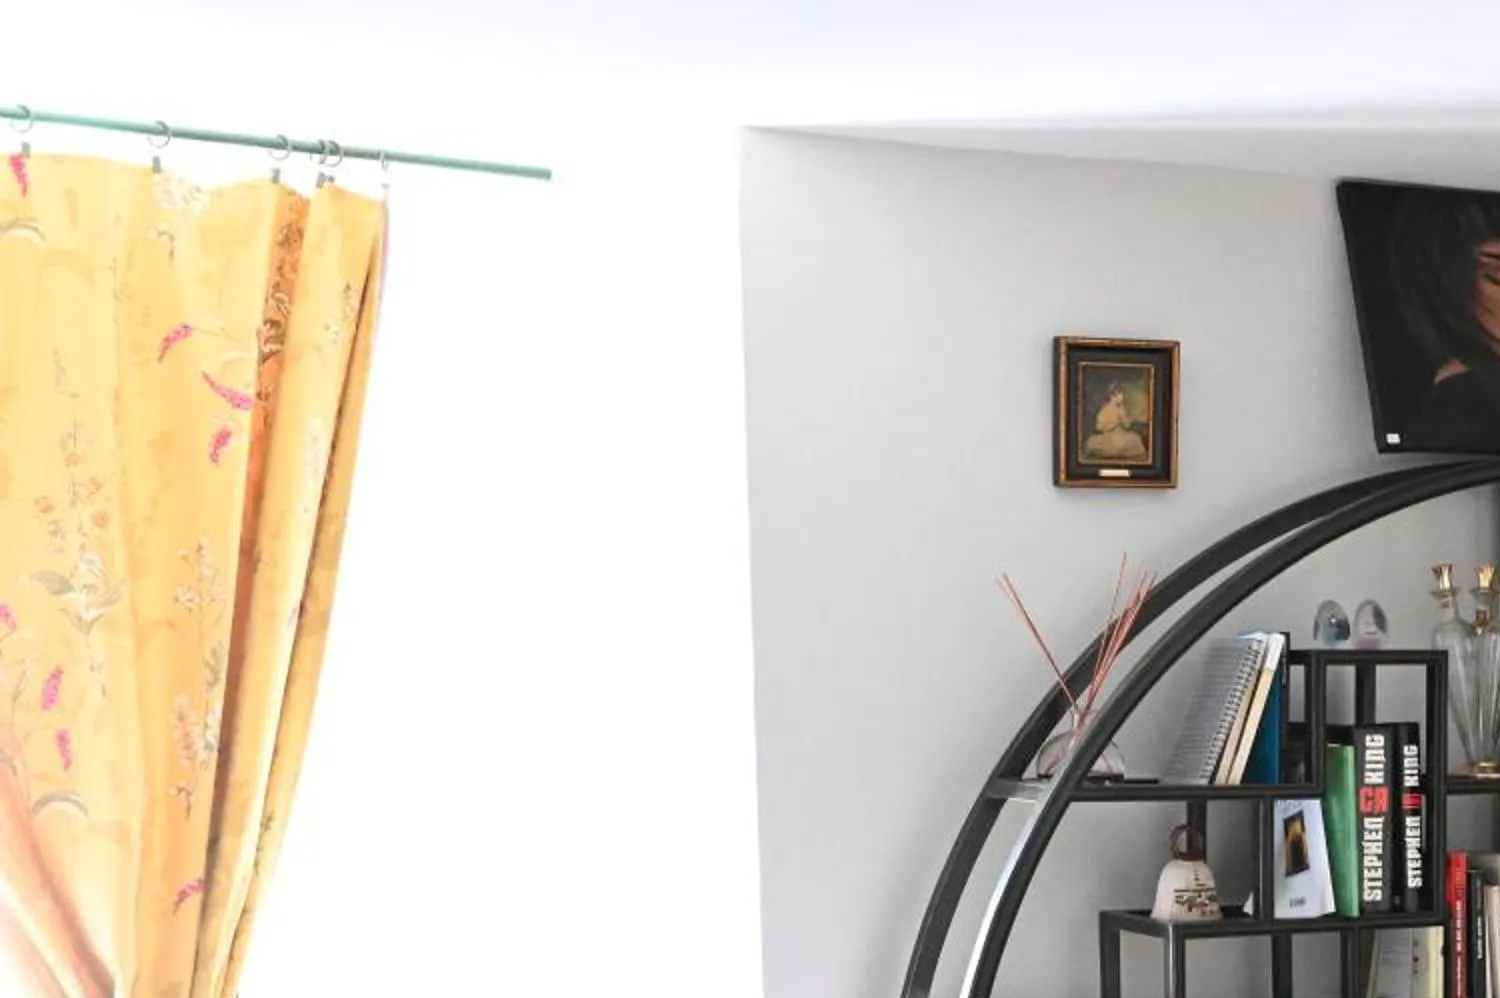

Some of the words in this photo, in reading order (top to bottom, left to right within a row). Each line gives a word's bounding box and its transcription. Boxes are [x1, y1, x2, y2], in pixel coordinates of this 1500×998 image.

[1365, 733, 1386, 784] KING
[1403, 744, 1420, 787] KING
[1363, 816, 1385, 902] STEPHEN
[1405, 815, 1423, 888] STEPHEN
